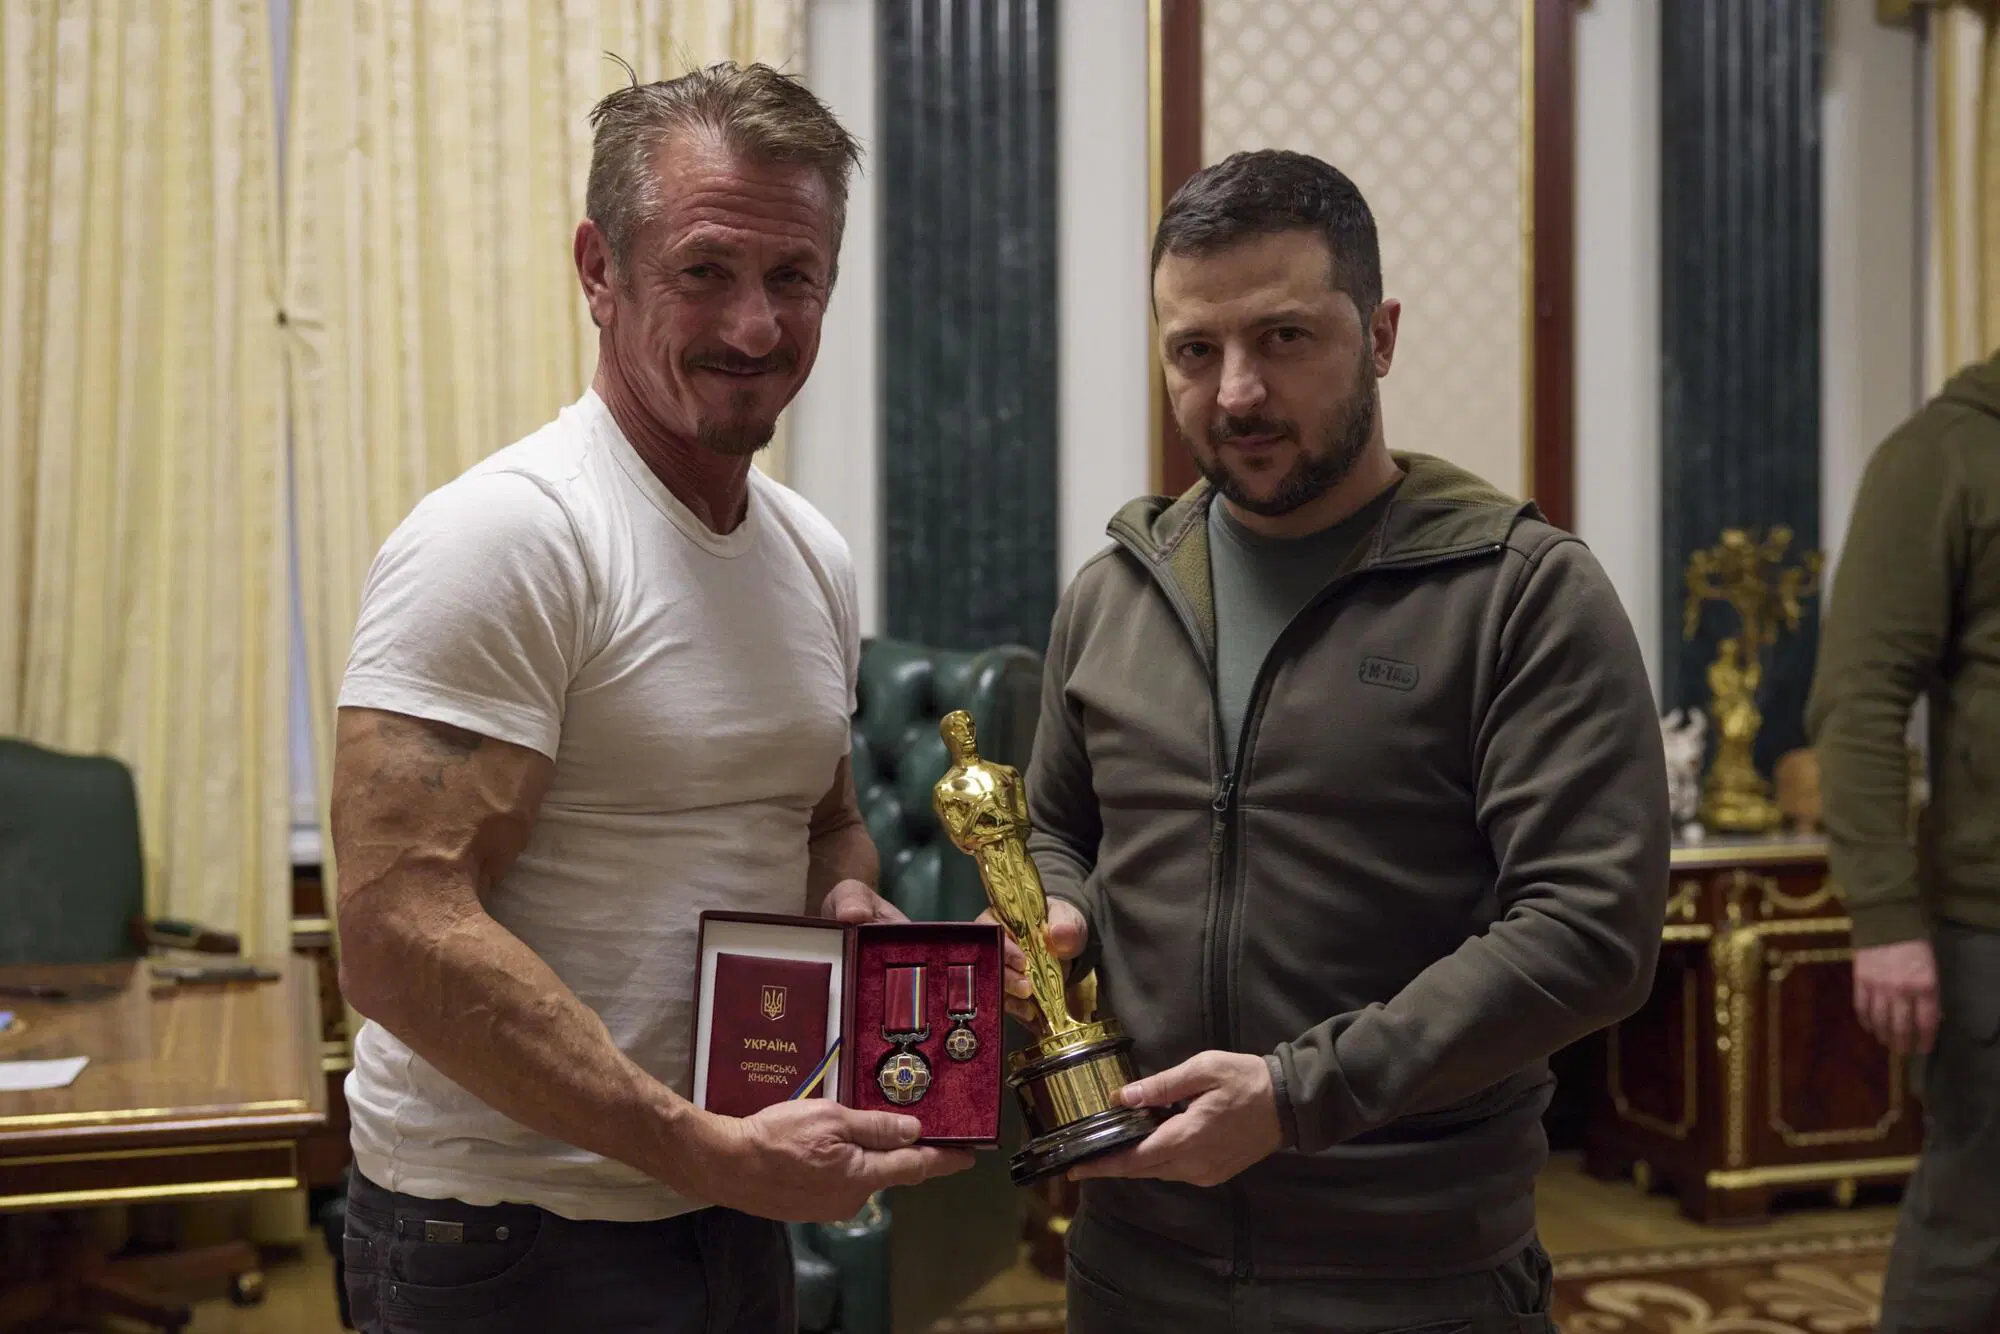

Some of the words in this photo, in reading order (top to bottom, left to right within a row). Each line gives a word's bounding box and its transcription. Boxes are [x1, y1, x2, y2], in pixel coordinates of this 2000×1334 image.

[743, 1038, 798, 1053] УКРАЇНА
[740, 1061, 798, 1075] ОРДЕНСЬКА
[748, 1073, 788, 1085] КНИЖКА
